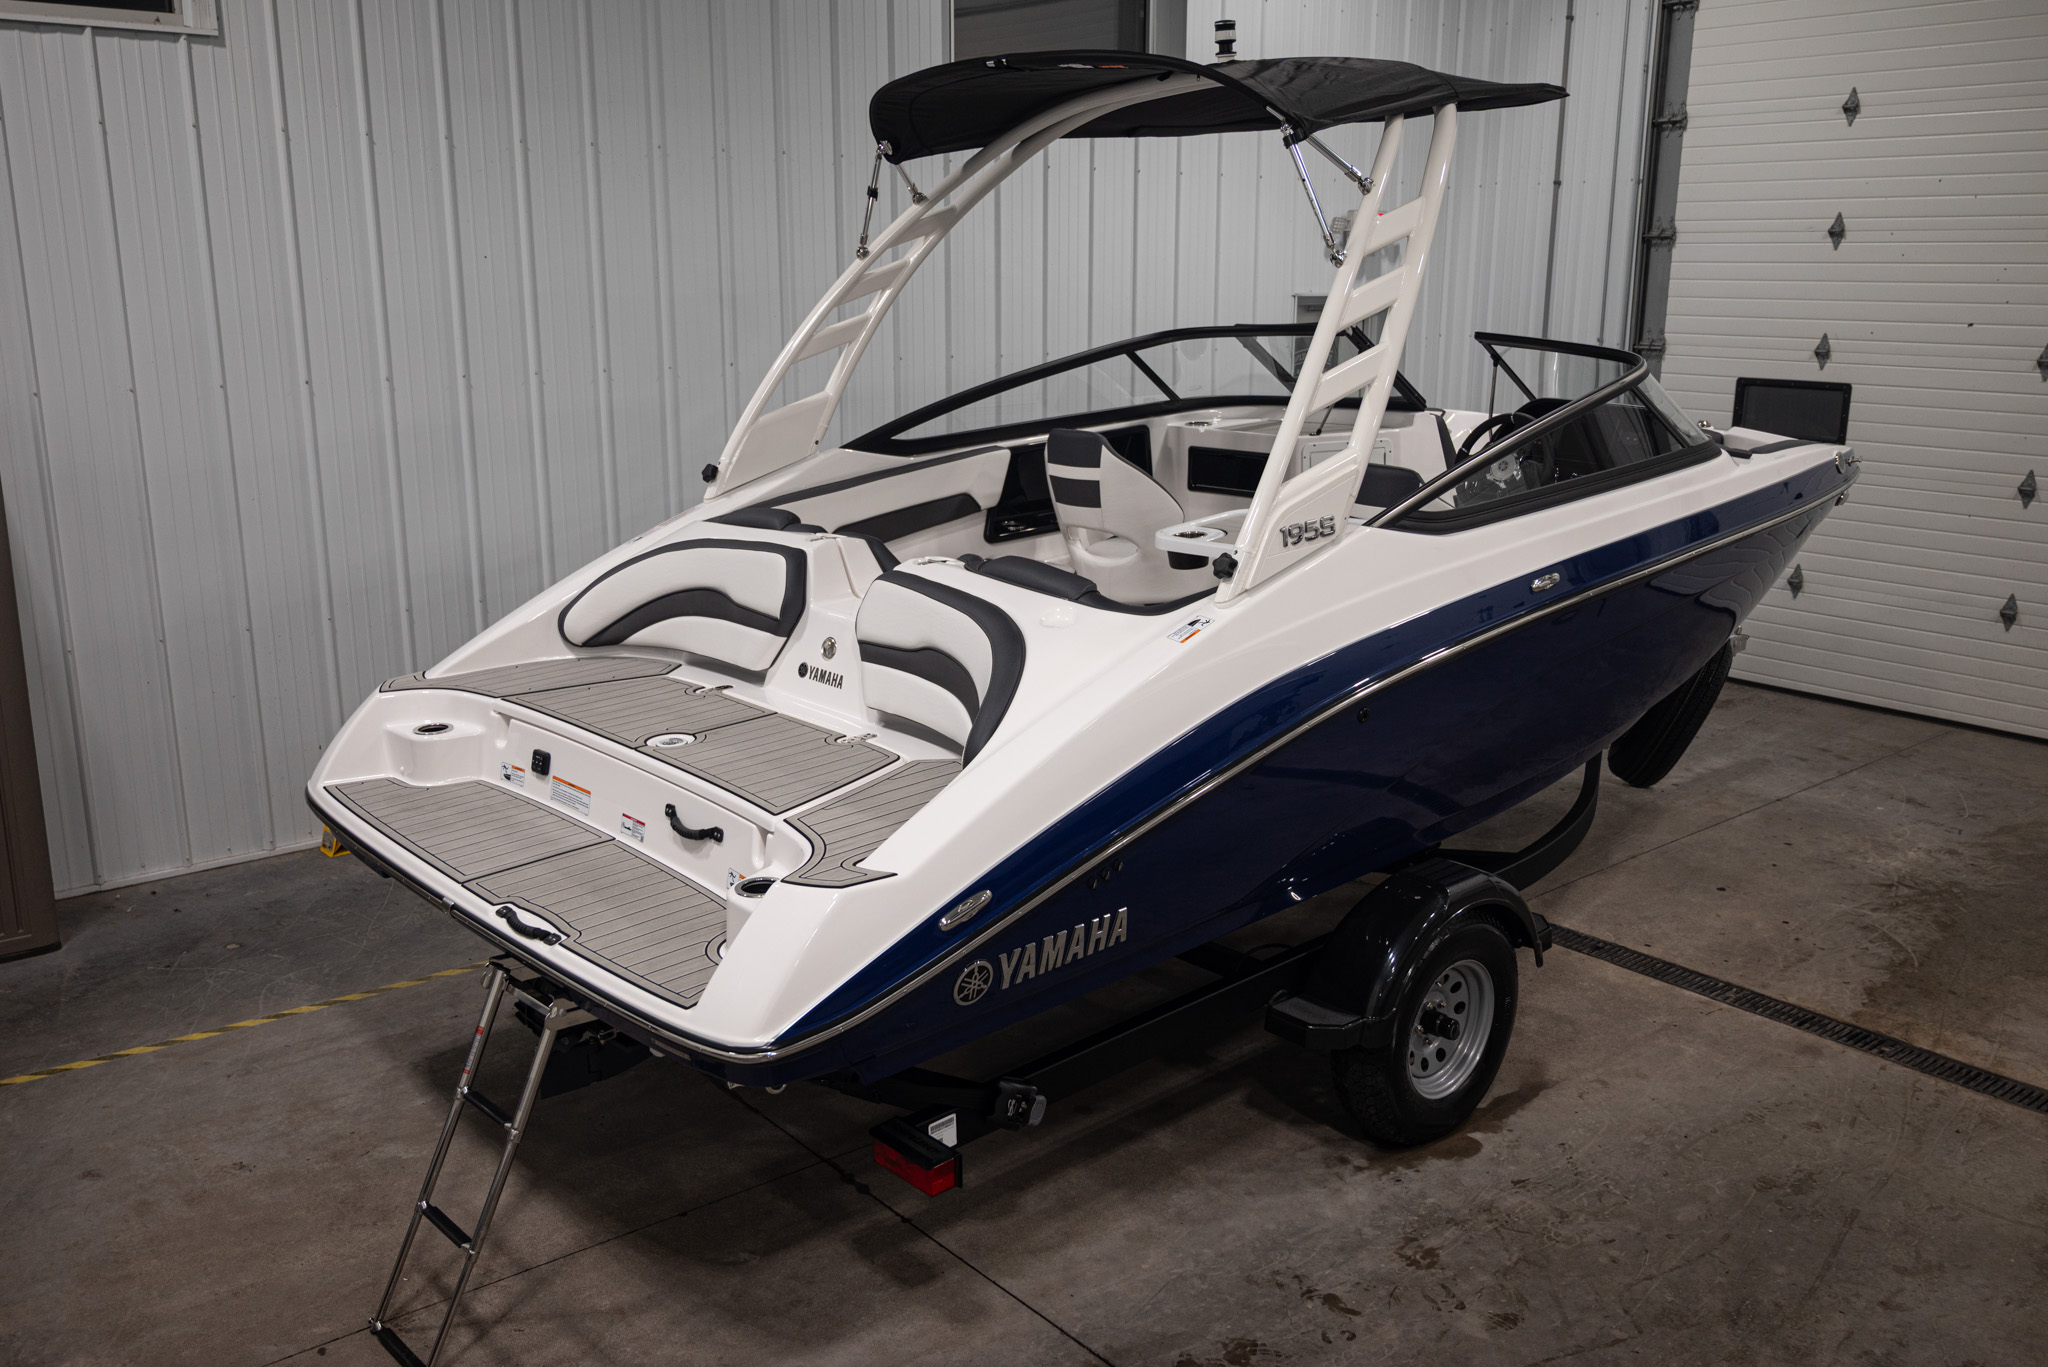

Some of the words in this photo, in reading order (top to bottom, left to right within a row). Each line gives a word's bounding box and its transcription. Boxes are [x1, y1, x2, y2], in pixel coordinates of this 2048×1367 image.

[1280, 515, 1336, 548] 195S
[808, 665, 844, 690] YAMAHA
[998, 906, 1128, 990] YAMAHA
